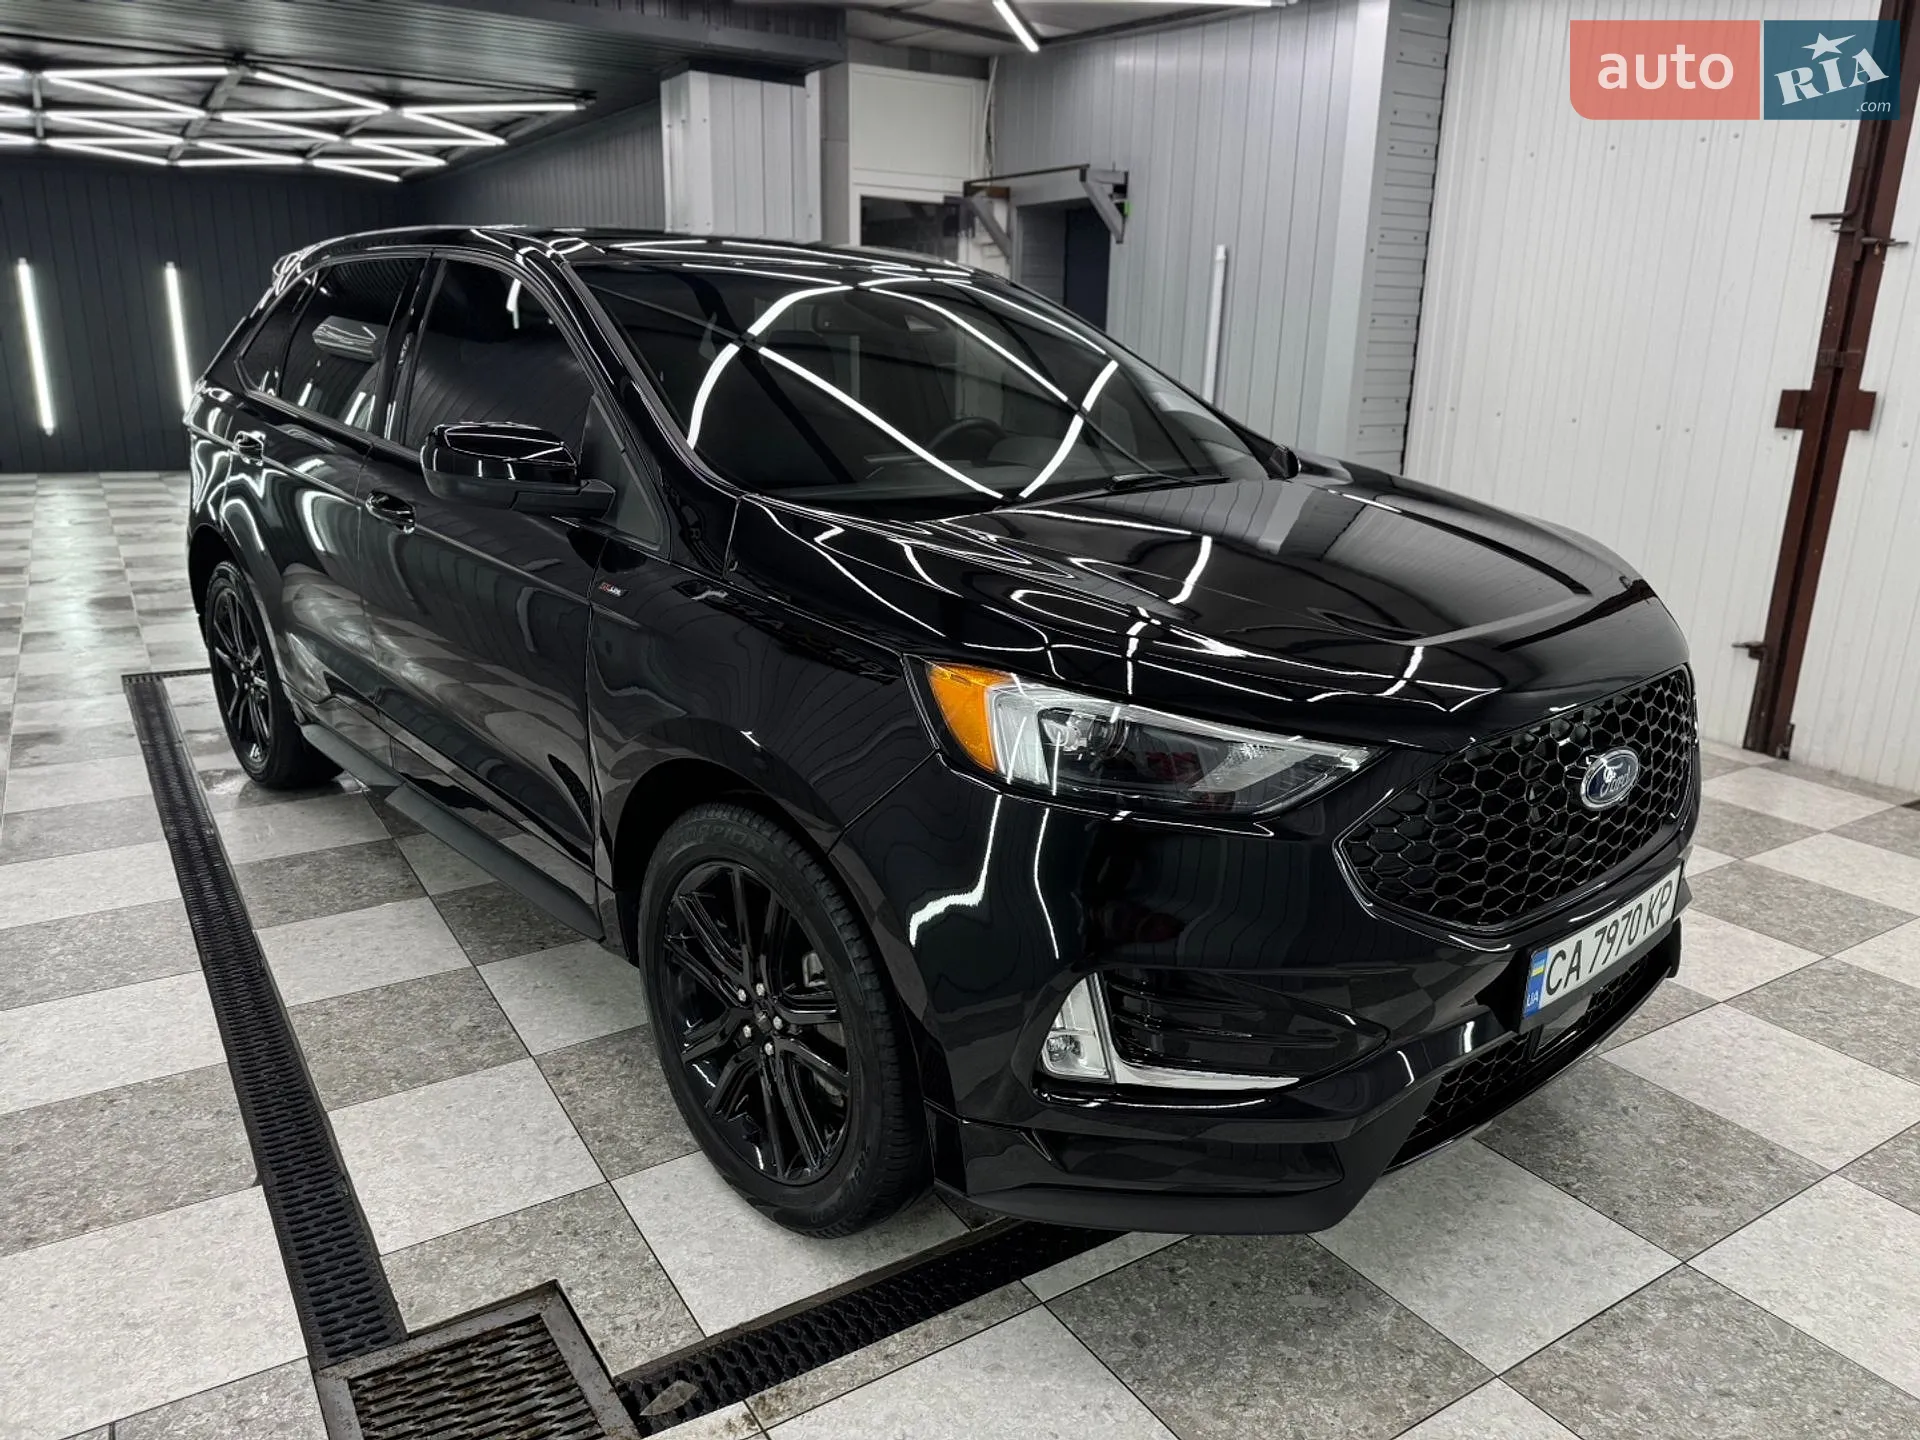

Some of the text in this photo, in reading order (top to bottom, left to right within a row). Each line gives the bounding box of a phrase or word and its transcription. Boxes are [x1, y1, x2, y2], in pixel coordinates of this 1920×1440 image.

[1546, 880, 1673, 996] CA 7970 KP
[1526, 990, 1539, 1007] UA
